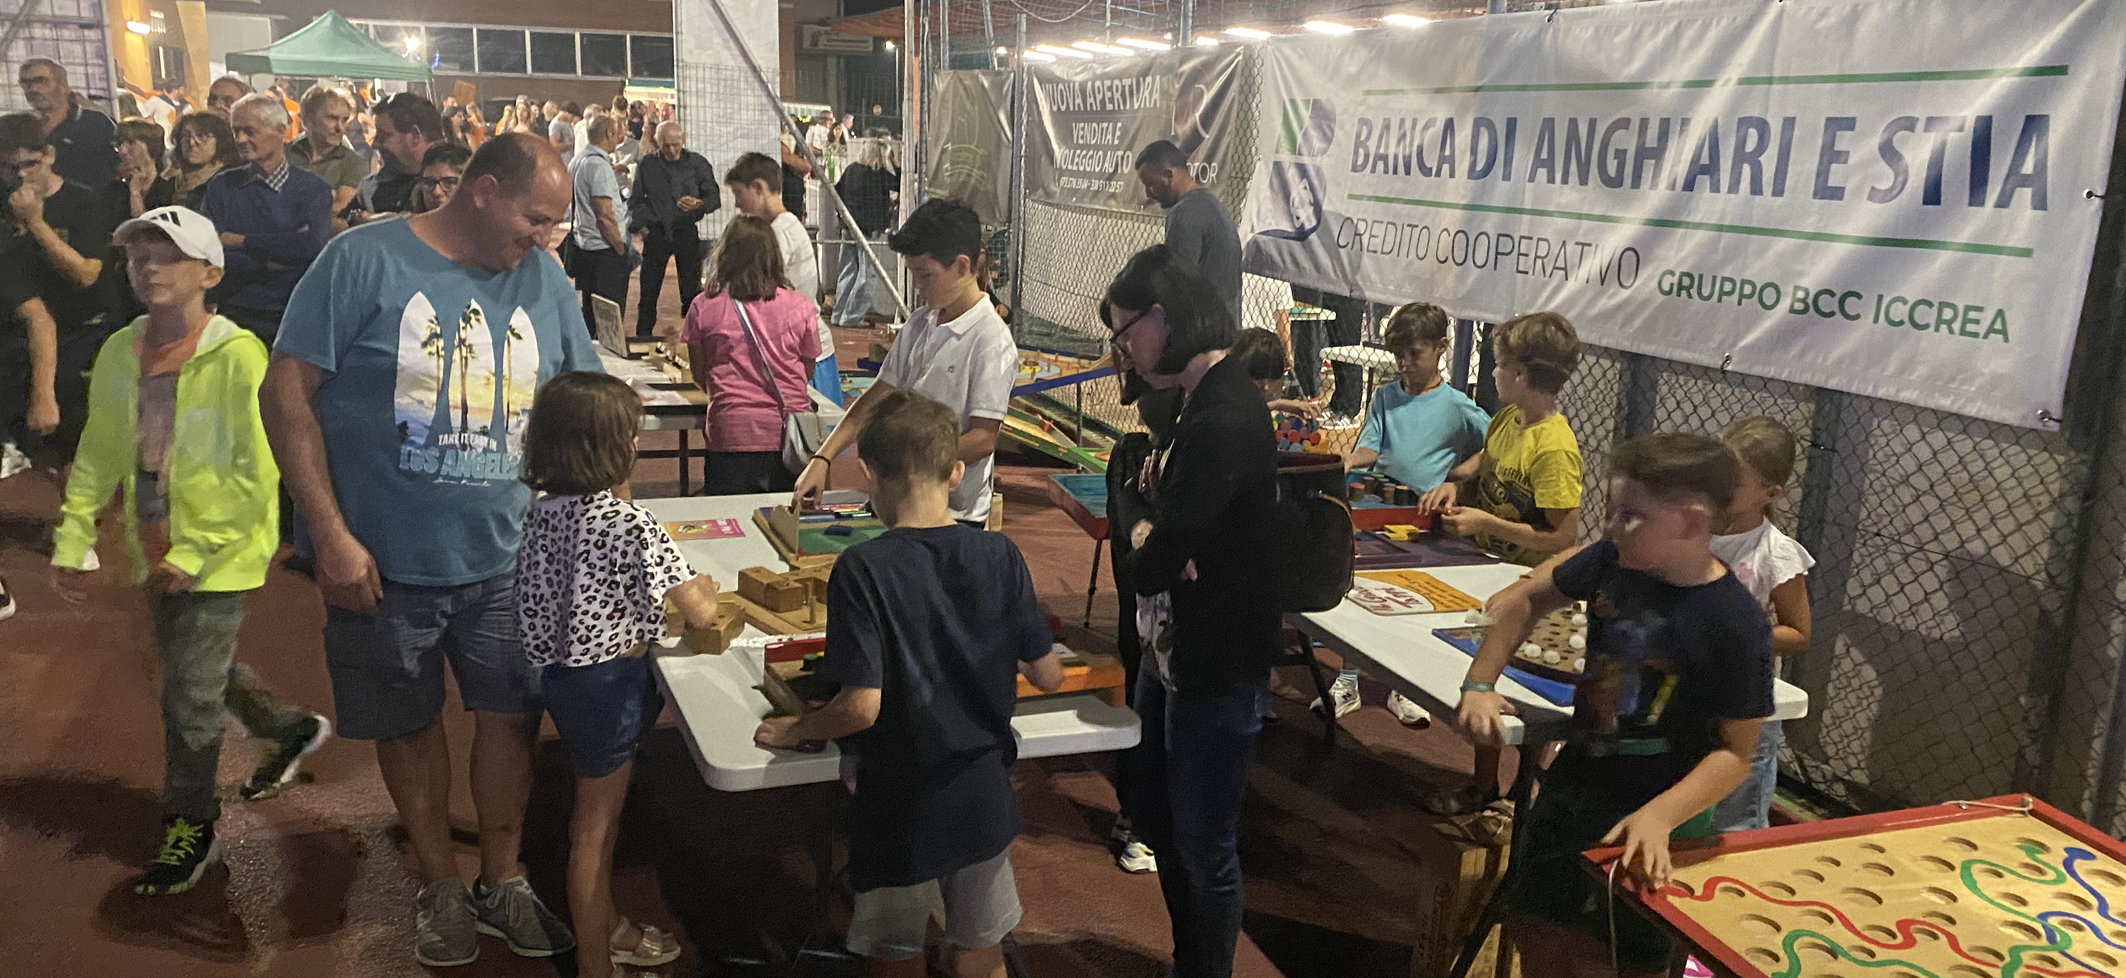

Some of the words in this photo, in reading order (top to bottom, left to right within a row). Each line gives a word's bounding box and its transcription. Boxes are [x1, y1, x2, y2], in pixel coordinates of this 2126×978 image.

[1042, 82, 1083, 112] NUOVA
[1086, 75, 1160, 111] APERTURA
[1053, 148, 1103, 173] NOLEGGIO
[1102, 150, 1132, 174] AUTO
[1072, 122, 1112, 145] VENDITA
[1113, 122, 1122, 145] E
[1350, 117, 1456, 179] BANCA
[1466, 116, 1518, 182] DI
[1527, 116, 1796, 198] ANGHIARI
[1812, 116, 1857, 201] E
[1866, 114, 2050, 211] STIA
[1336, 216, 1431, 262] CREDITO
[1435, 227, 1641, 290] COOPERATIVO
[1657, 269, 1782, 311] GRUPPO
[1788, 285, 1864, 322] BCC
[1872, 293, 2011, 344] ICCREA
